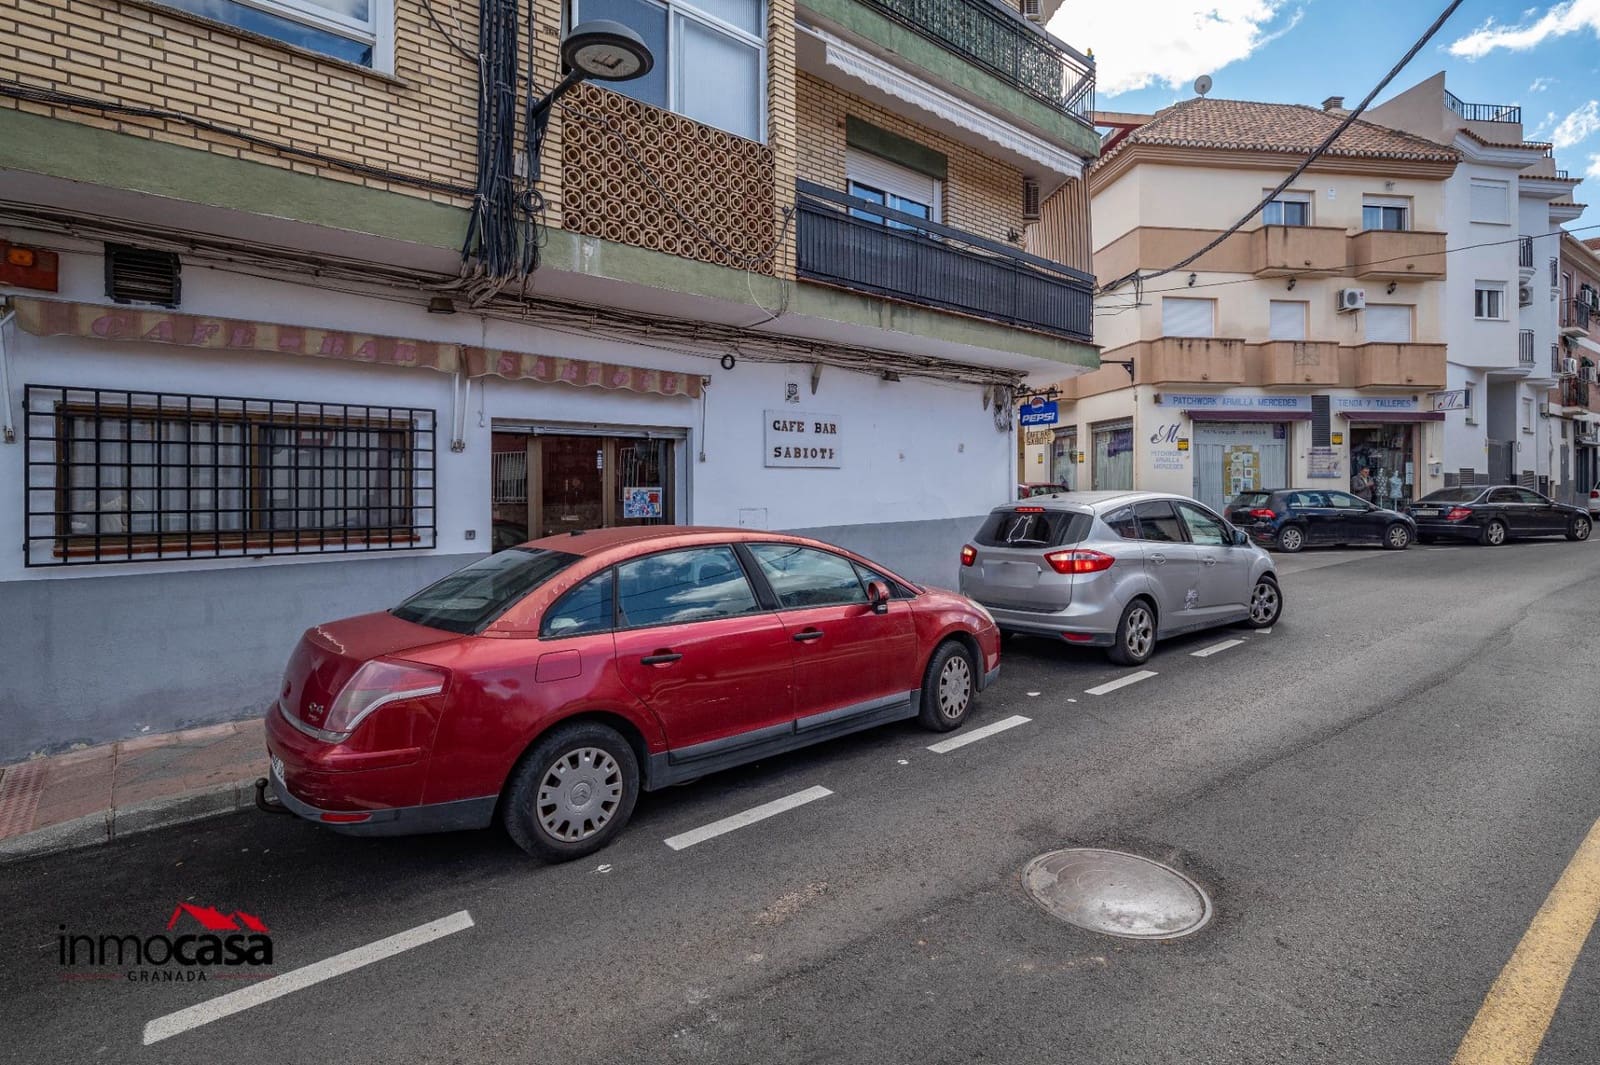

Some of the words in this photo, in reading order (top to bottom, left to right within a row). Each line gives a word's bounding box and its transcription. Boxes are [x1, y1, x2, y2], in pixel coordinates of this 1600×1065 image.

[1173, 396, 1217, 405] PATCHWORK
[1221, 397, 1254, 406] ARMILLA
[1258, 398, 1297, 407] MERCEDES
[1338, 399, 1362, 407] TIENDA
[1376, 399, 1411, 408] TALLERES
[1022, 412, 1056, 423] PEPSI
[773, 420, 805, 432] CAFE
[814, 422, 837, 434] BAR
